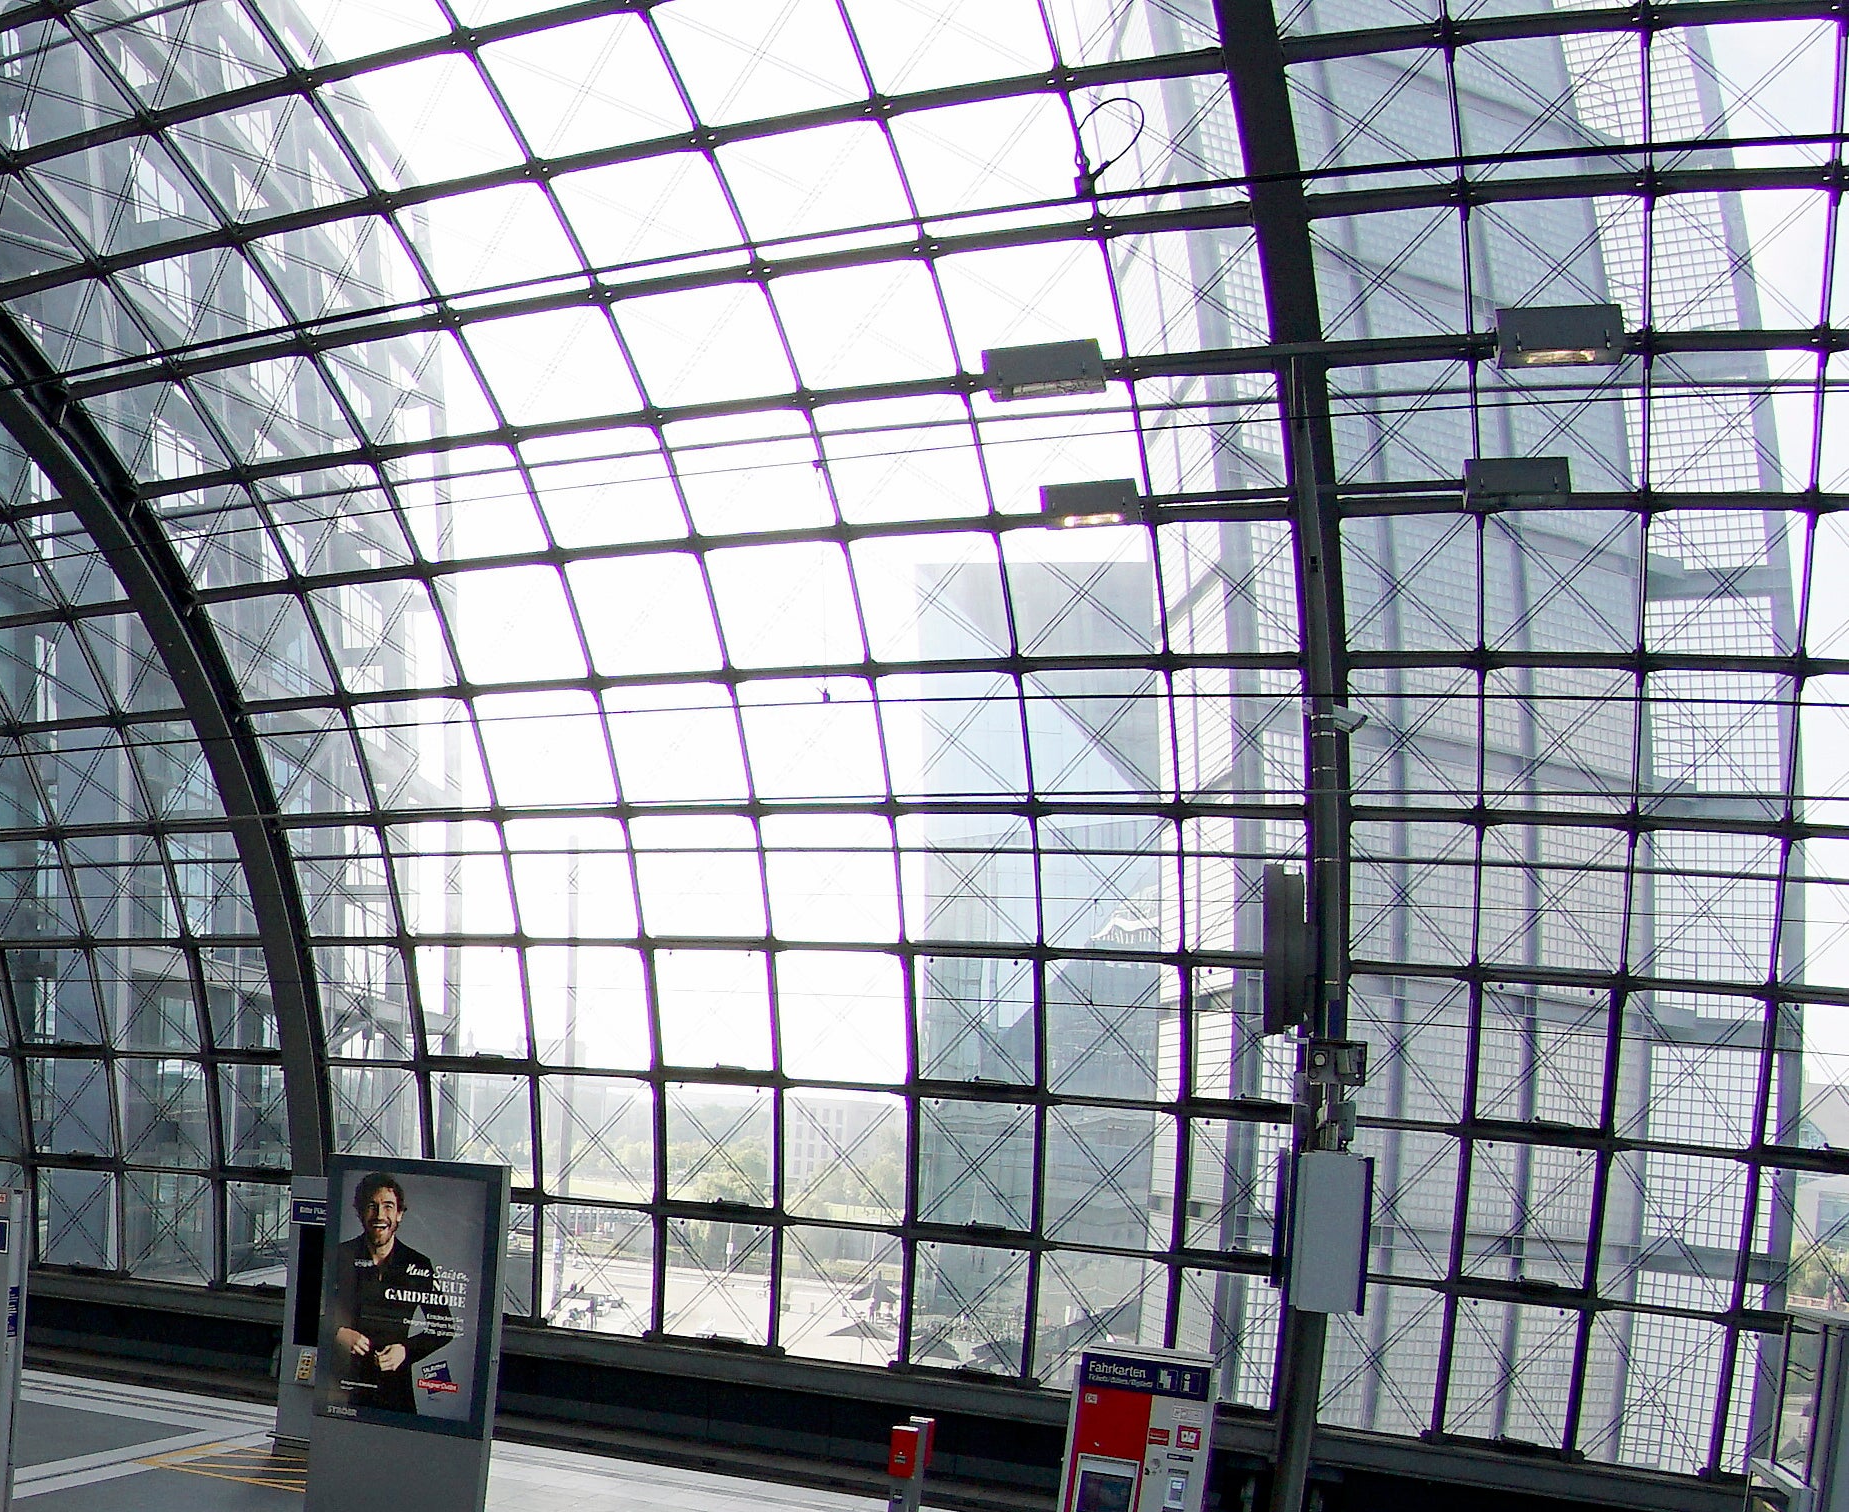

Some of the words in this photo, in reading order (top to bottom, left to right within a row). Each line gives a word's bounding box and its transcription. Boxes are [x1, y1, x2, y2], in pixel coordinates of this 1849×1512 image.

[432, 1280, 467, 1295] NEUE
[384, 1288, 466, 1308] GARDEROBE
[1089, 1360, 1147, 1378] Fahrkarten
